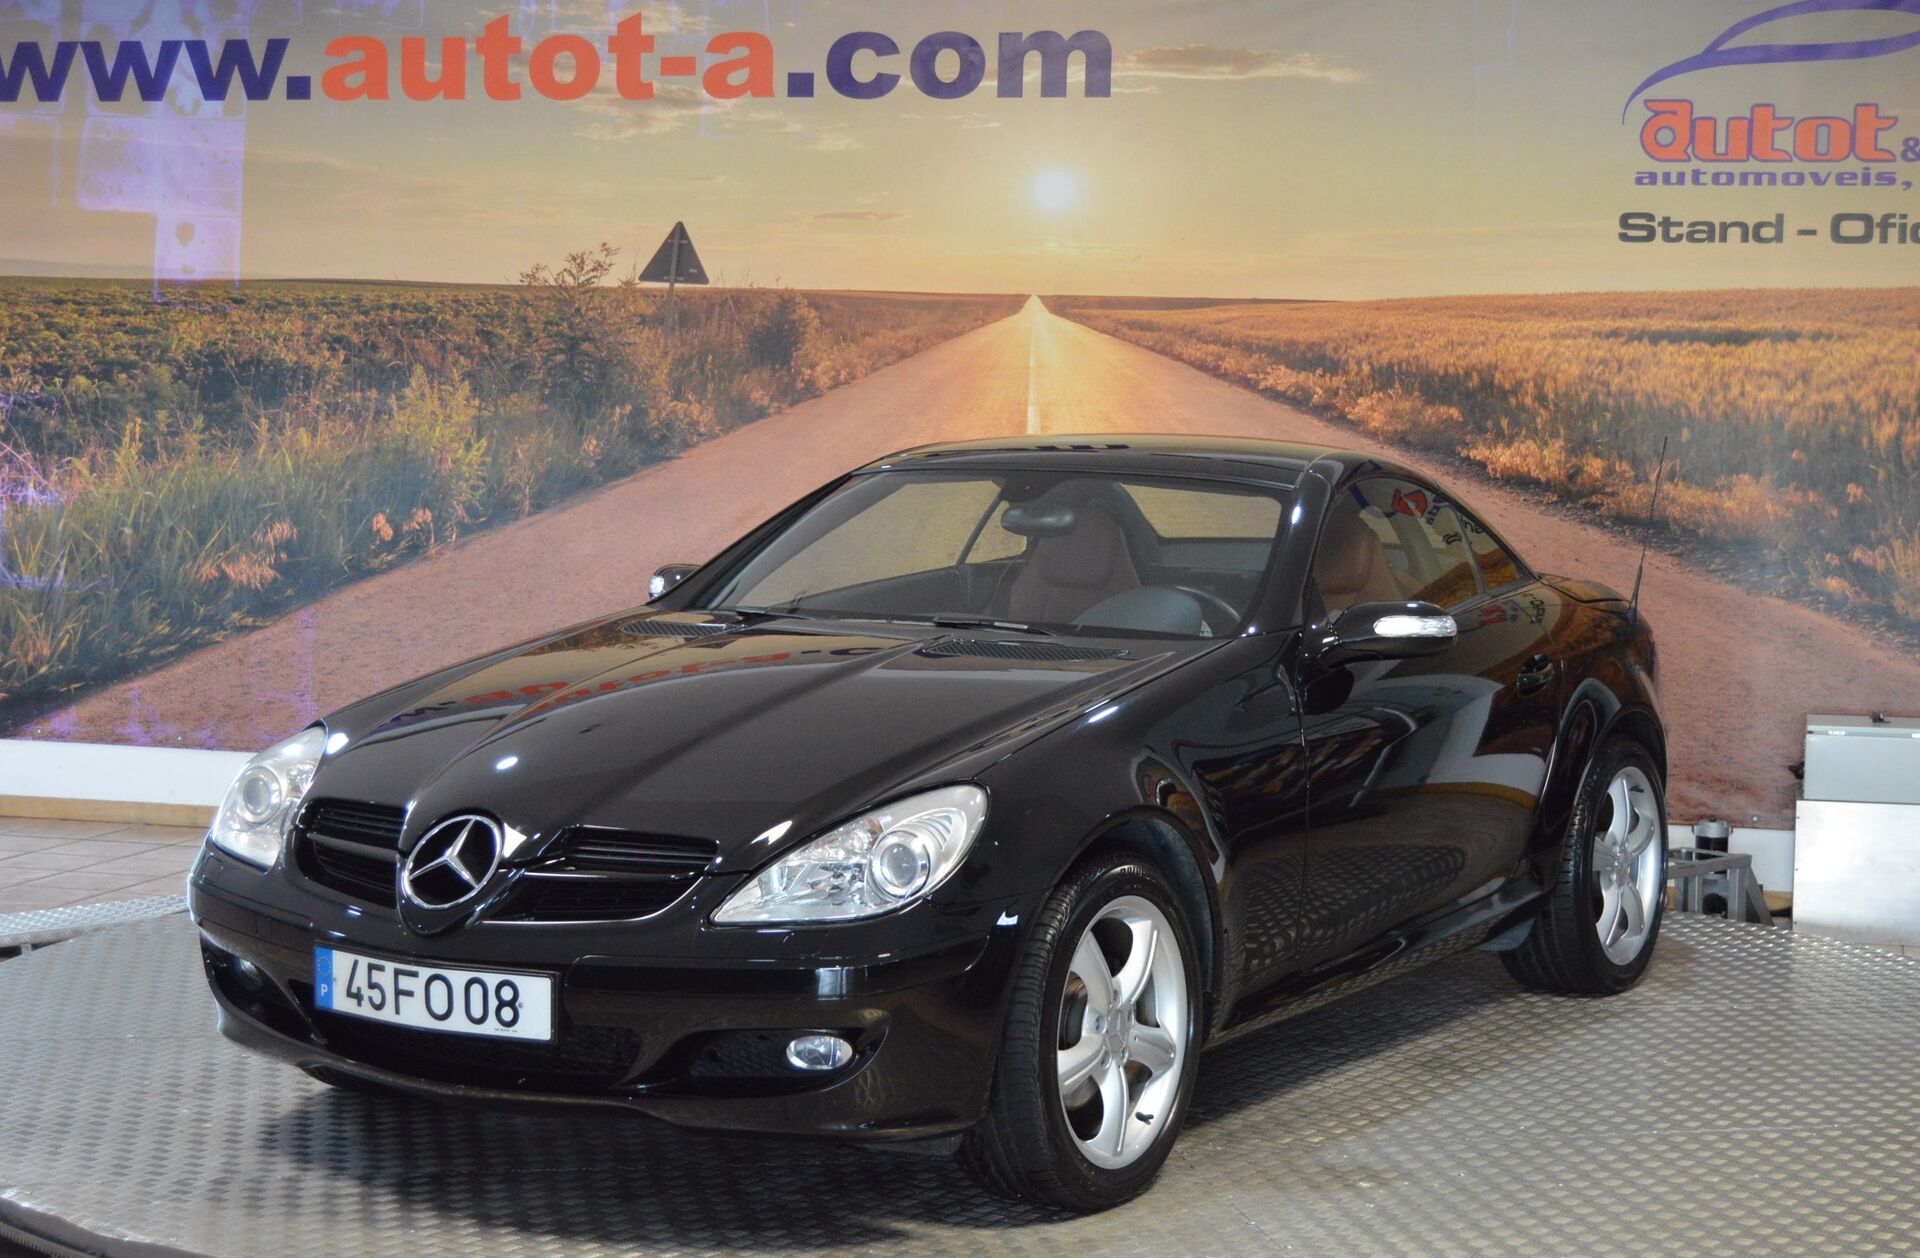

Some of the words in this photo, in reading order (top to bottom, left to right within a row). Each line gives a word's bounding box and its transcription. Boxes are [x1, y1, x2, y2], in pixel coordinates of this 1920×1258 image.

[0, 11, 1112, 101] www.autot-a.com
[1640, 99, 1898, 163] autot
[1634, 167, 1912, 191] automoveis,
[1618, 212, 1784, 244] Stand
[320, 983, 329, 997] P
